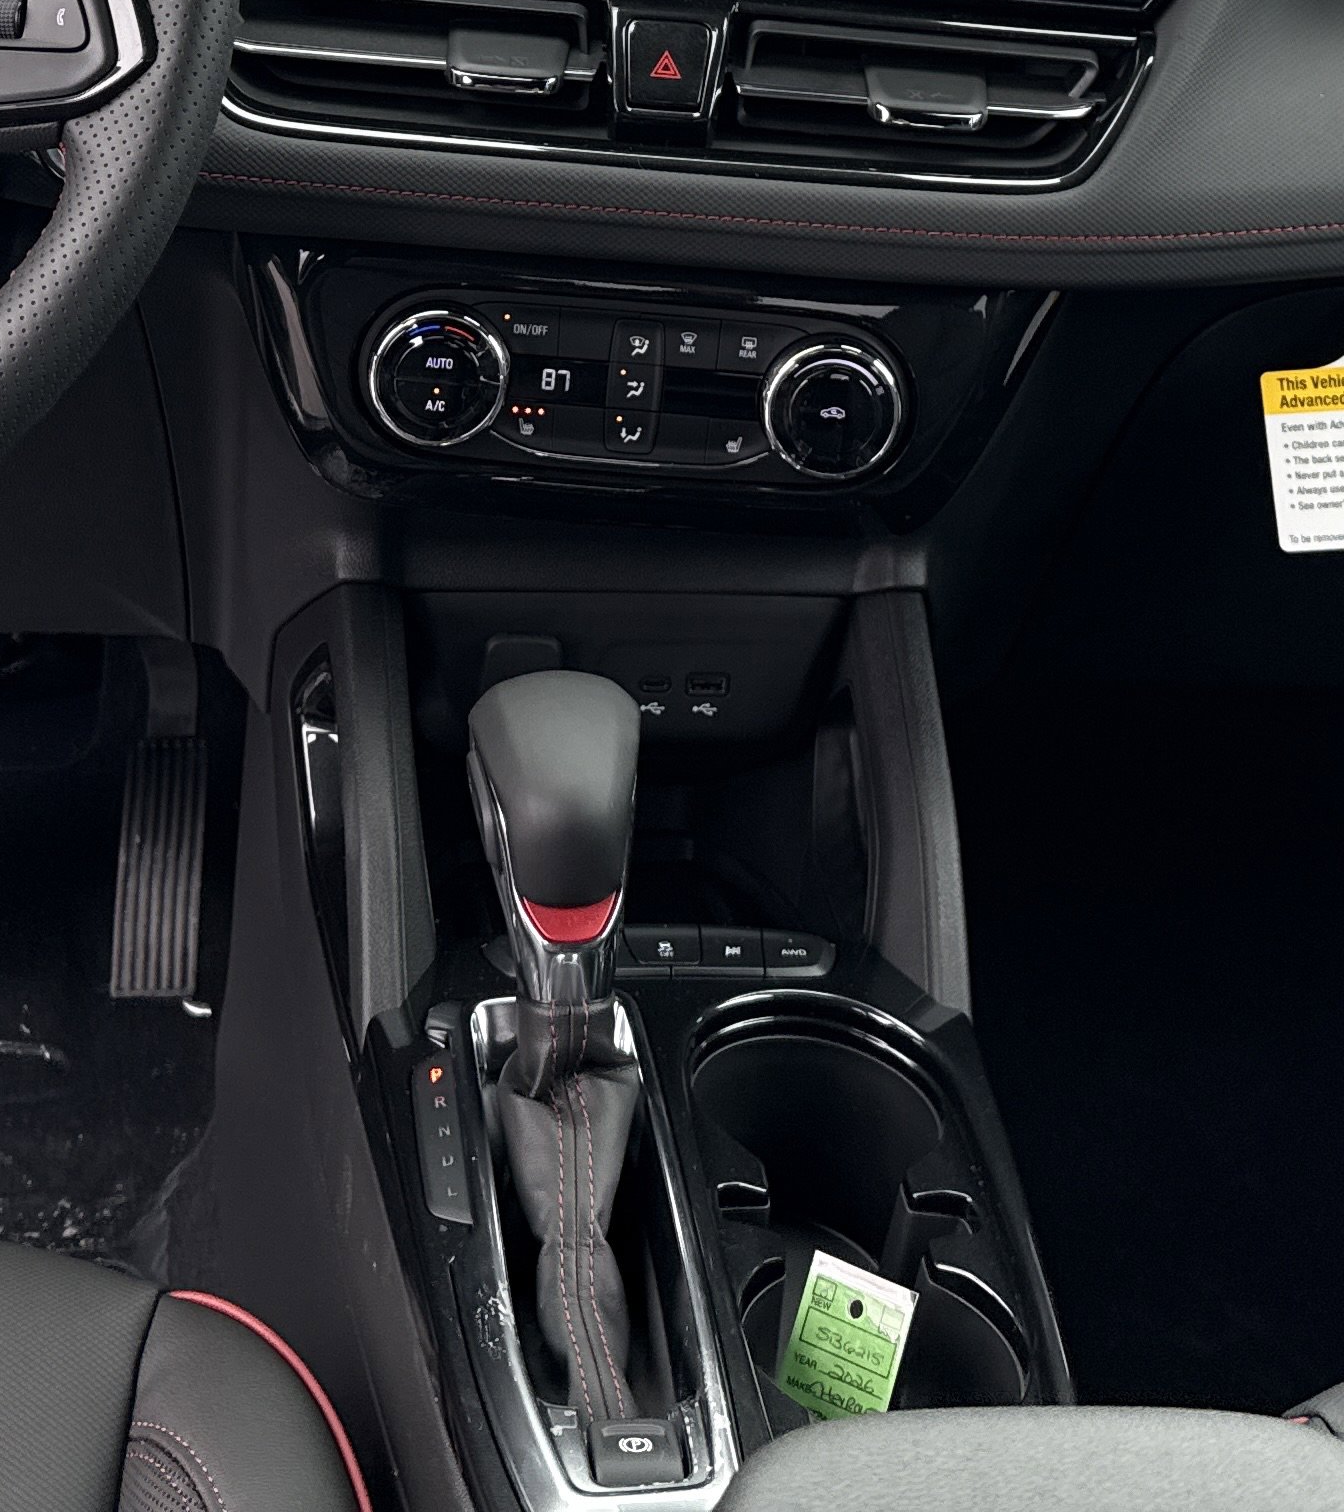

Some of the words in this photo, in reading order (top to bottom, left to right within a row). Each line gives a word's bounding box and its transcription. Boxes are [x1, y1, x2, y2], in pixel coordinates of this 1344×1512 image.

[513, 323, 549, 336] ON/OFF
[679, 344, 696, 354] MAX
[738, 349, 758, 359] REAR
[425, 356, 454, 370] AUTO
[541, 368, 571, 392] 87
[1277, 377, 1307, 392] This
[424, 399, 446, 412] A/C
[1281, 422, 1305, 433] Even
[1307, 421, 1327, 431] with
[781, 948, 807, 957] AWD
[429, 1067, 444, 1084] P
[434, 1095, 447, 1108] R
[438, 1125, 451, 1138] N
[447, 1187, 458, 1197] L
[794, 1351, 818, 1370] YEAR
